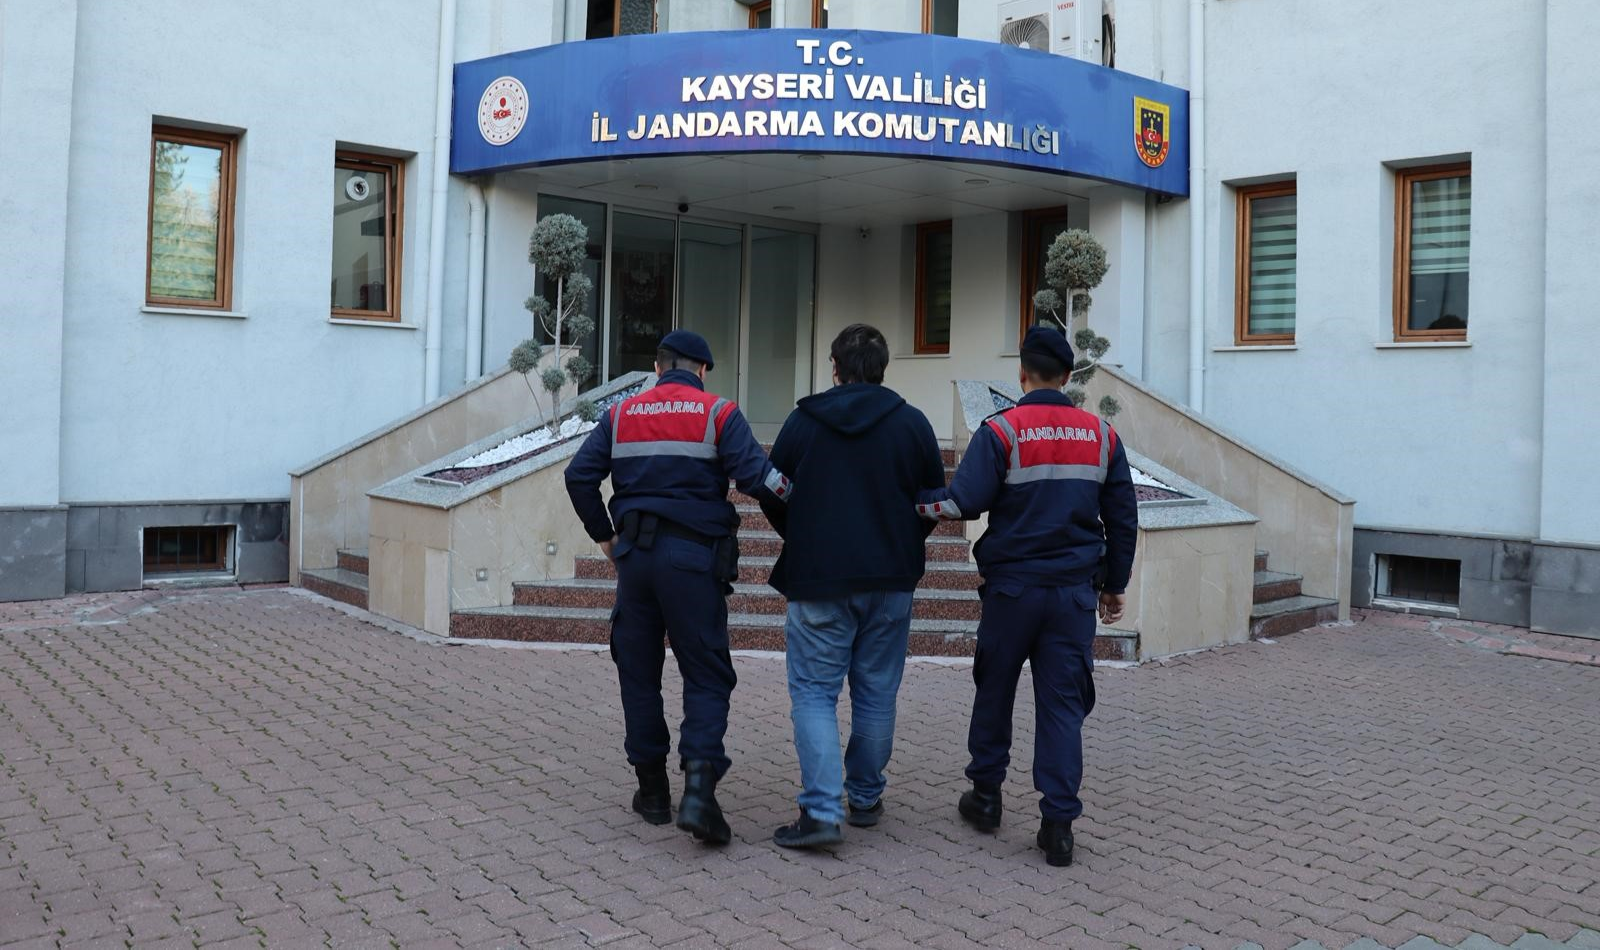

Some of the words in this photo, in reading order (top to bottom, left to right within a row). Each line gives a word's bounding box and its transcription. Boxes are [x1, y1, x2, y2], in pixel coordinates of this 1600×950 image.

[796, 39, 865, 66] T.C.
[681, 69, 834, 103] KAYSERİ
[845, 71, 987, 110] VALİLİĞİ
[591, 111, 618, 142] İL
[627, 110, 825, 141] JANDARMA
[832, 111, 1061, 155] KOMUTANLIĞI
[626, 401, 705, 416] JANDARMA
[1018, 426, 1098, 443] JANDARMA
